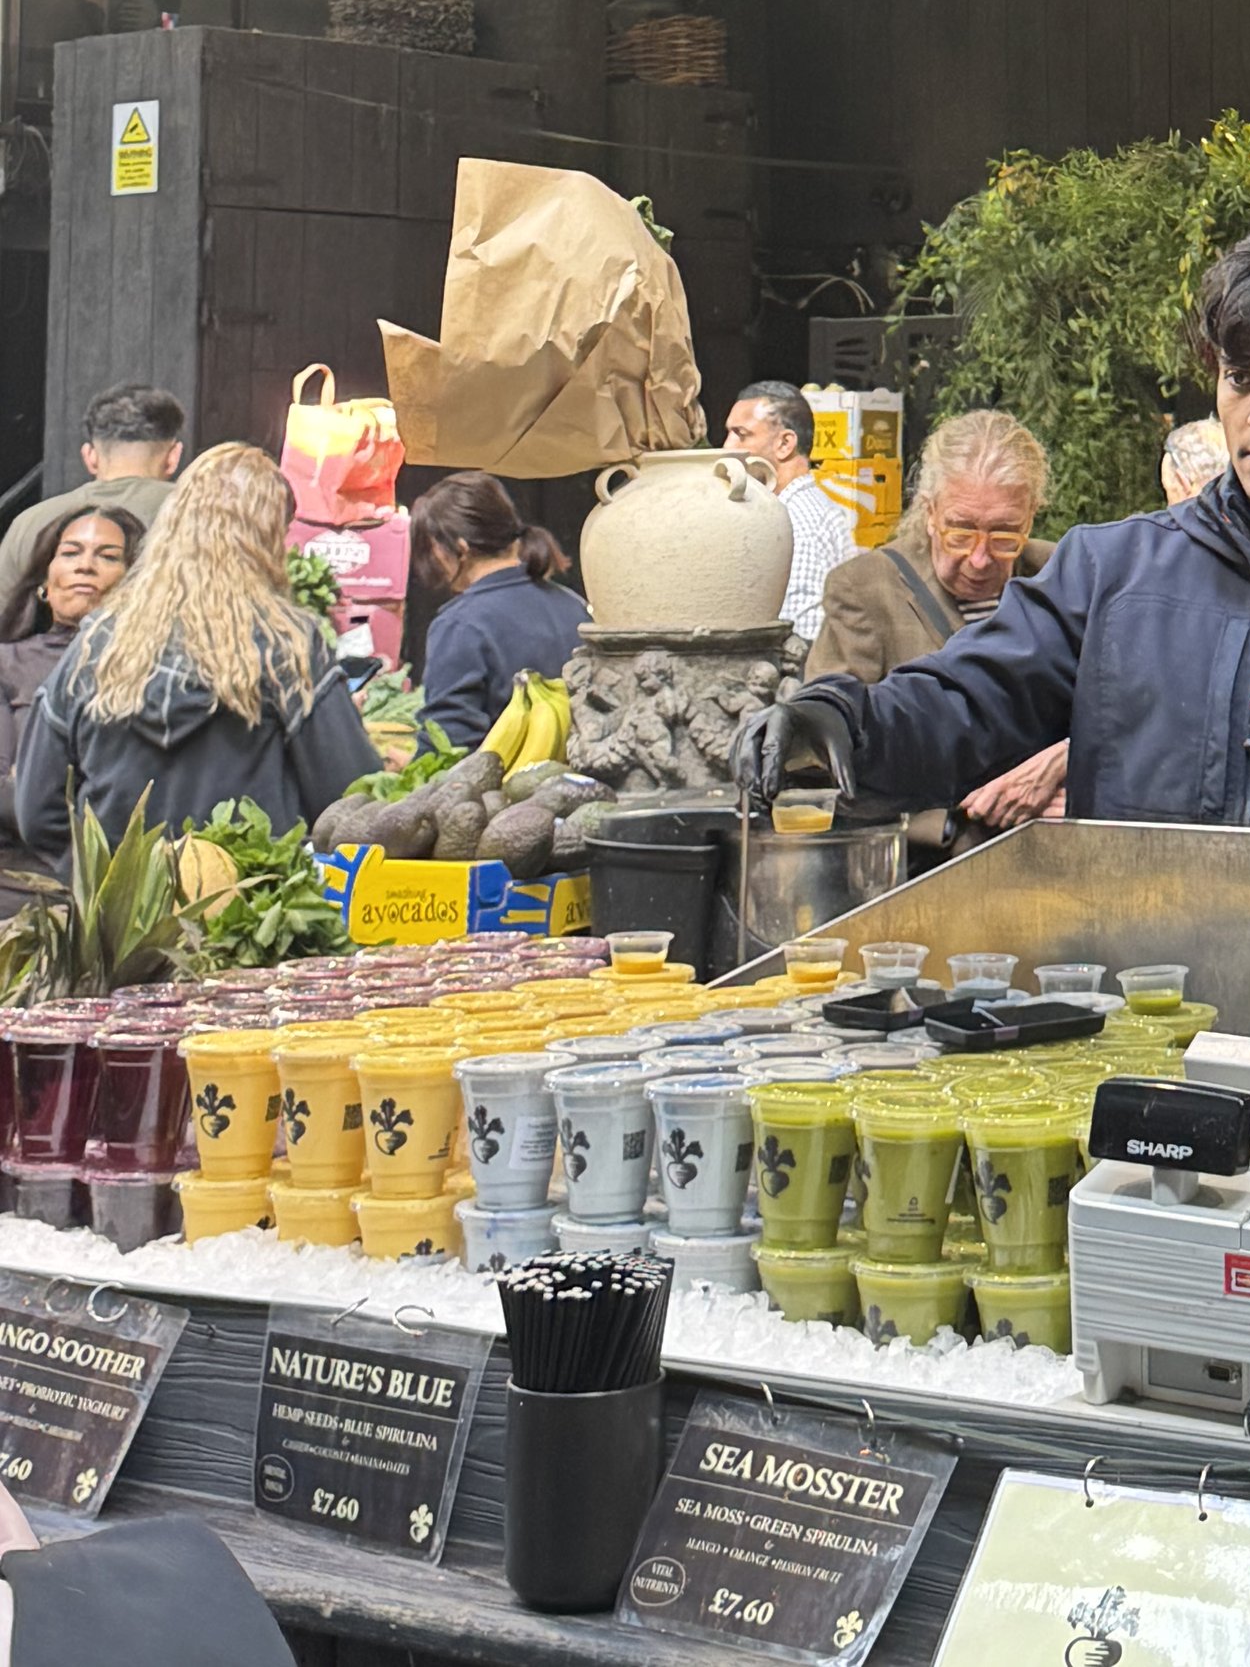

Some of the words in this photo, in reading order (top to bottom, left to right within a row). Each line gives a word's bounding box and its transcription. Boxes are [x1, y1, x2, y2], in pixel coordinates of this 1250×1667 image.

[362, 894, 459, 932] avocados
[1127, 1140, 1193, 1160] SHARP
[47, 1336, 146, 1381] SOOTHER
[269, 1346, 386, 1395] NATURE'S
[387, 1368, 455, 1409] BLUE
[77, 1395, 130, 1422] YOGHURT
[272, 1402, 304, 1421] HEMP
[304, 1409, 340, 1431] SEEDS
[342, 1418, 374, 1438] BLUE
[375, 1425, 438, 1451] SPIRULINA
[699, 1441, 754, 1479] SEA
[755, 1455, 904, 1516] MOSSTER
[311, 1487, 360, 1522] £7.60
[674, 1498, 700, 1517] SEA
[703, 1504, 745, 1526] MOSS
[749, 1514, 803, 1540] GREEN
[802, 1527, 878, 1558] SPIRULINA
[651, 1561, 674, 1578] VITAL
[685, 1536, 721, 1554] MANGO
[729, 1547, 771, 1567] ORANGE
[774, 1558, 815, 1577] PASSION
[812, 1566, 844, 1584] FRUIT
[707, 1587, 774, 1626] £7.60
